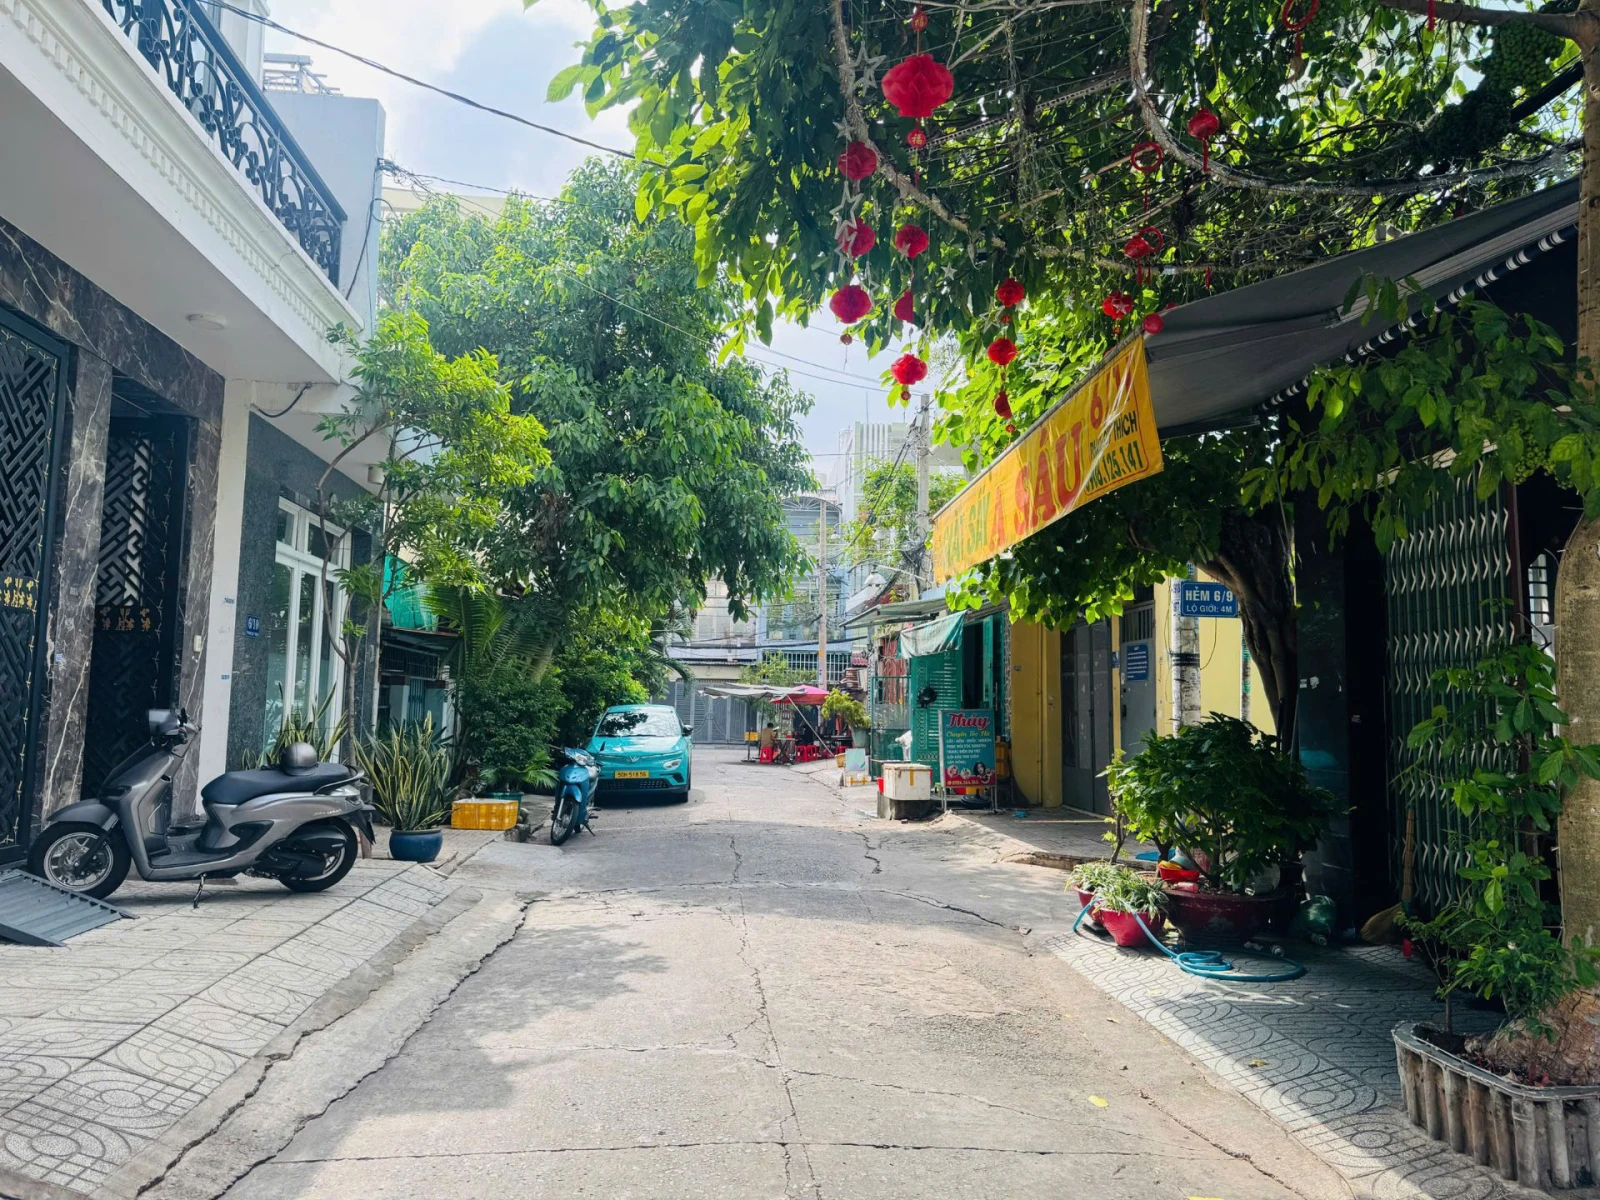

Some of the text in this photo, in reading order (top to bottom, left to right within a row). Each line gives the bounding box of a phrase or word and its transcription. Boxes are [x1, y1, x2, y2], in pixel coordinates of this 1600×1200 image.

[1014, 420, 1083, 536] SÁU
[1185, 586, 1210, 602] HẺM
[1214, 590, 1233, 603] 6/9
[1186, 604, 1197, 613] LỘ
[1220, 605, 1232, 613] 4M
